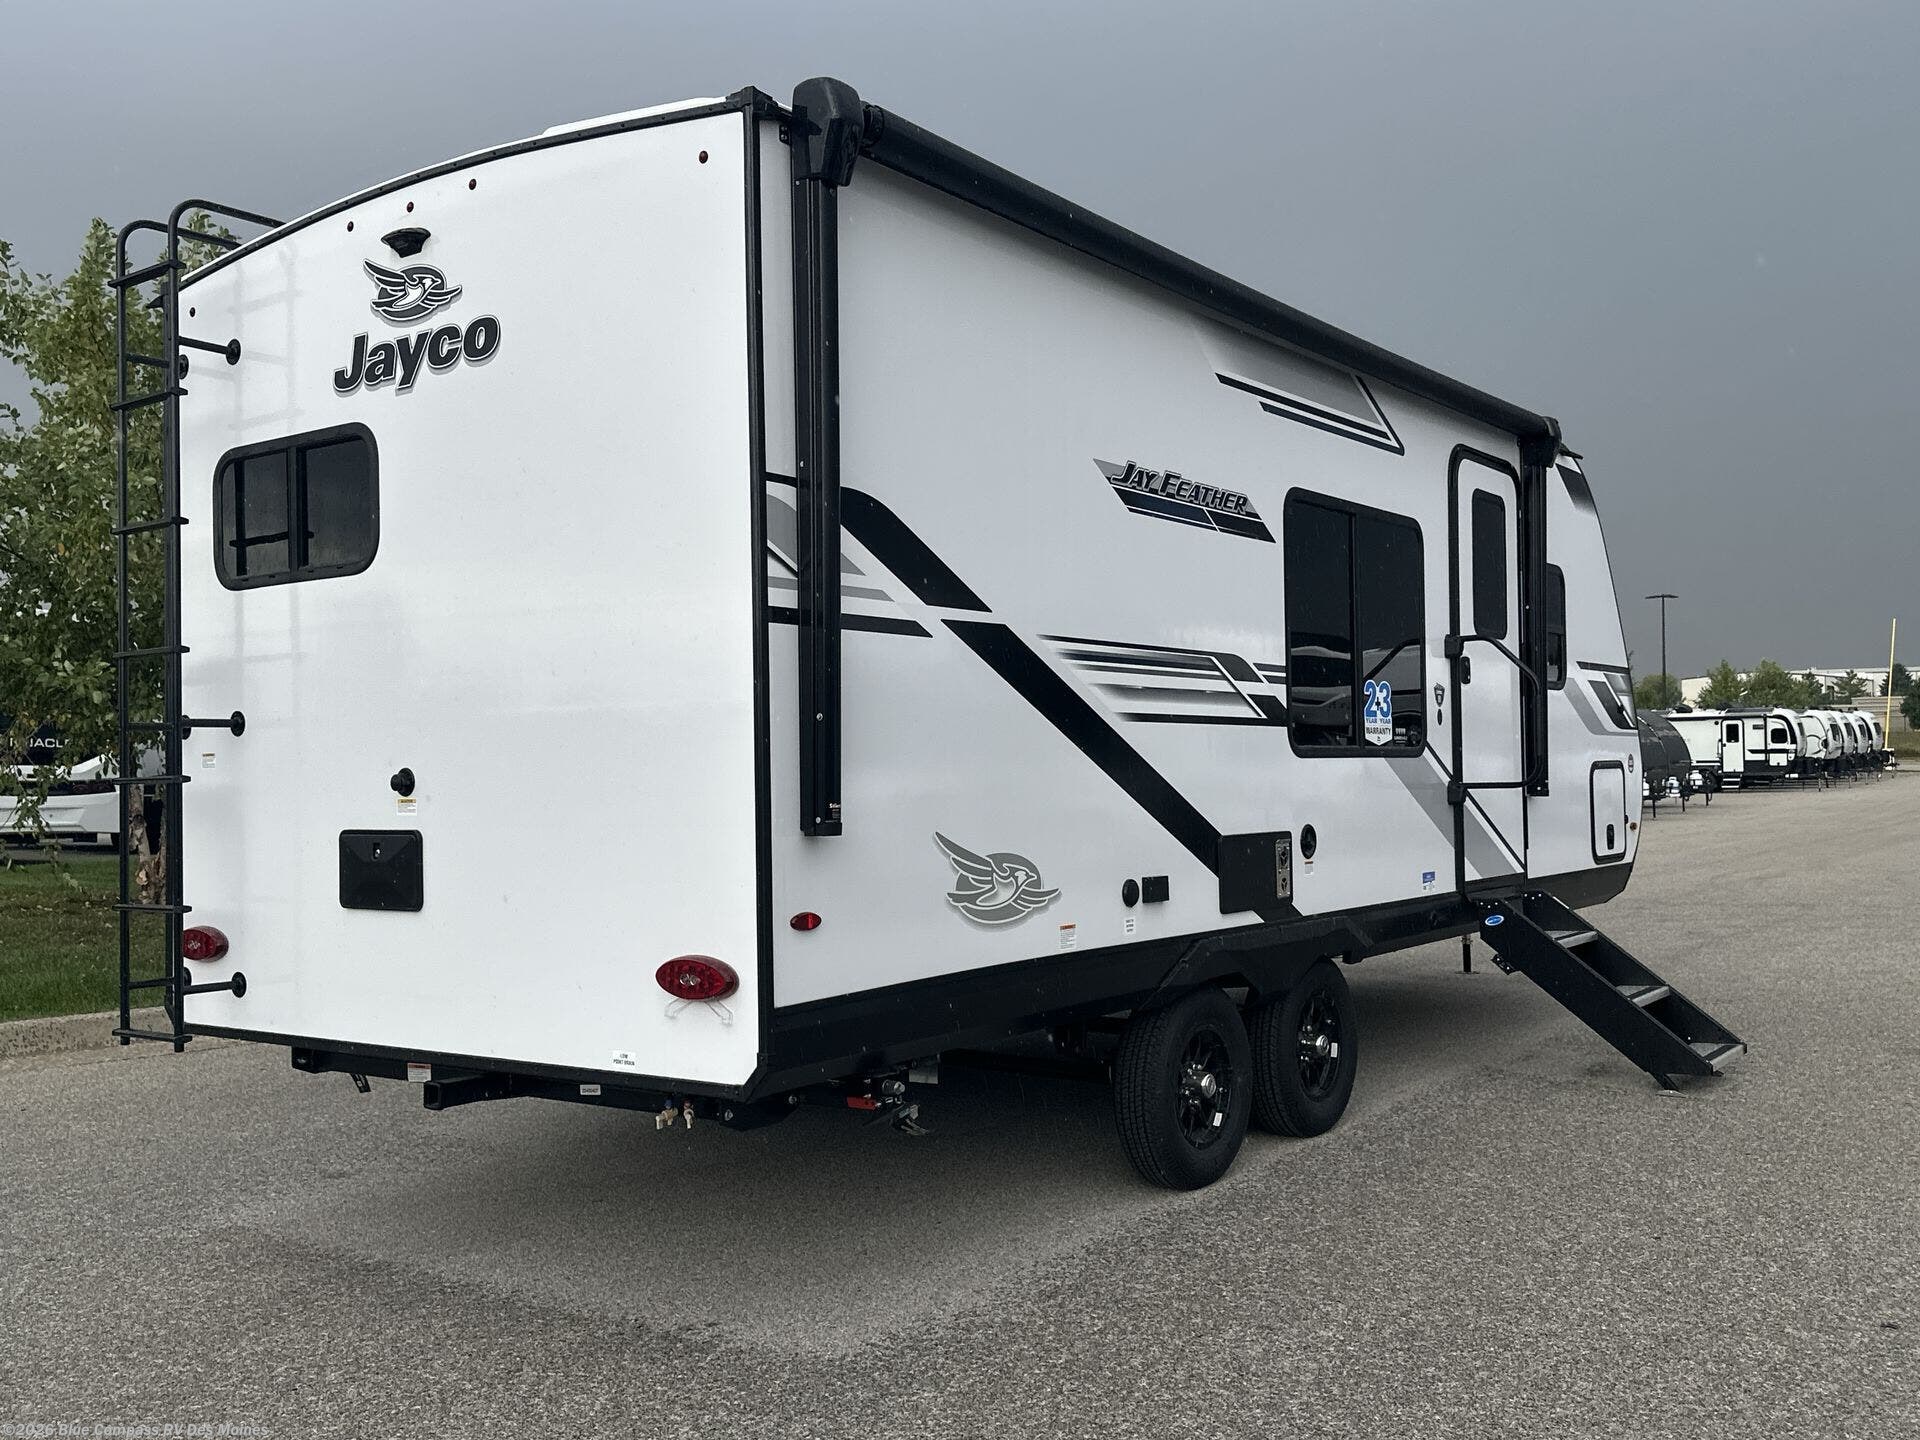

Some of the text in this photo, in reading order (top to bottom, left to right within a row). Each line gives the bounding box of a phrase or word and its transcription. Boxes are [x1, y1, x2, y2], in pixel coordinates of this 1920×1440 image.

[333, 315, 501, 392] Jayco
[1111, 461, 1249, 515] JAY FEATHER
[1366, 726, 1391, 735] WARRANTY
